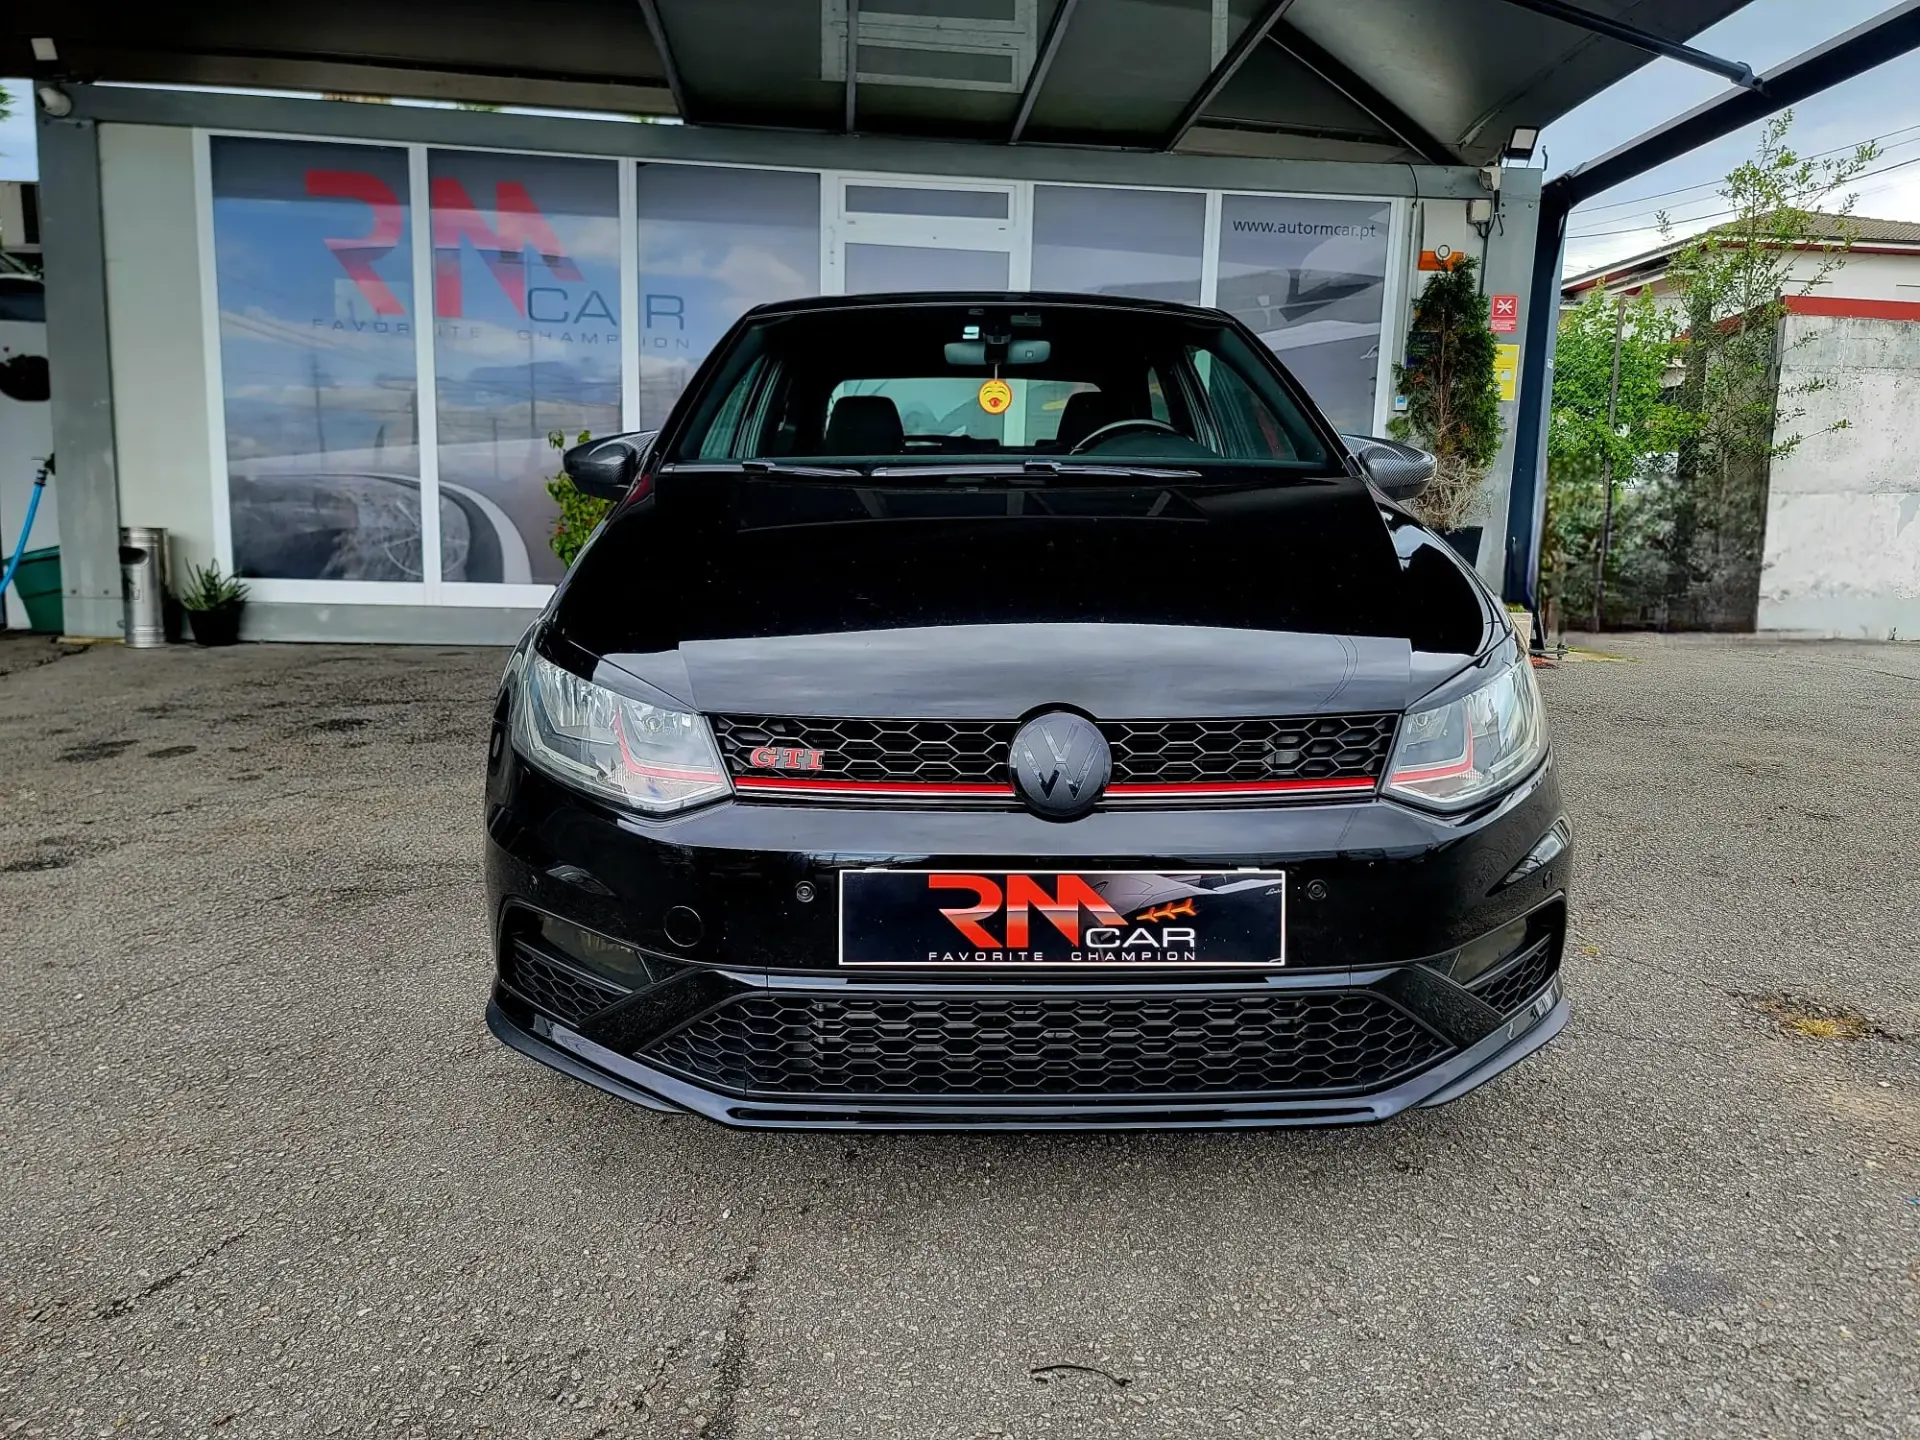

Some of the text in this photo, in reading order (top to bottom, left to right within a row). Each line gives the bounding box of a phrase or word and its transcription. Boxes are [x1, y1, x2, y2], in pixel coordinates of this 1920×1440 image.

[1233, 219, 1376, 239] www.autormcar.pt
[305, 169, 585, 318] RM
[527, 287, 685, 331] CAR
[312, 318, 690, 349] FAVORITE CHAMPION
[749, 746, 825, 771] GTI
[928, 874, 1128, 948] RM
[1085, 927, 1196, 948] CAR
[928, 951, 1196, 961] FAVORITE CHAMPION
